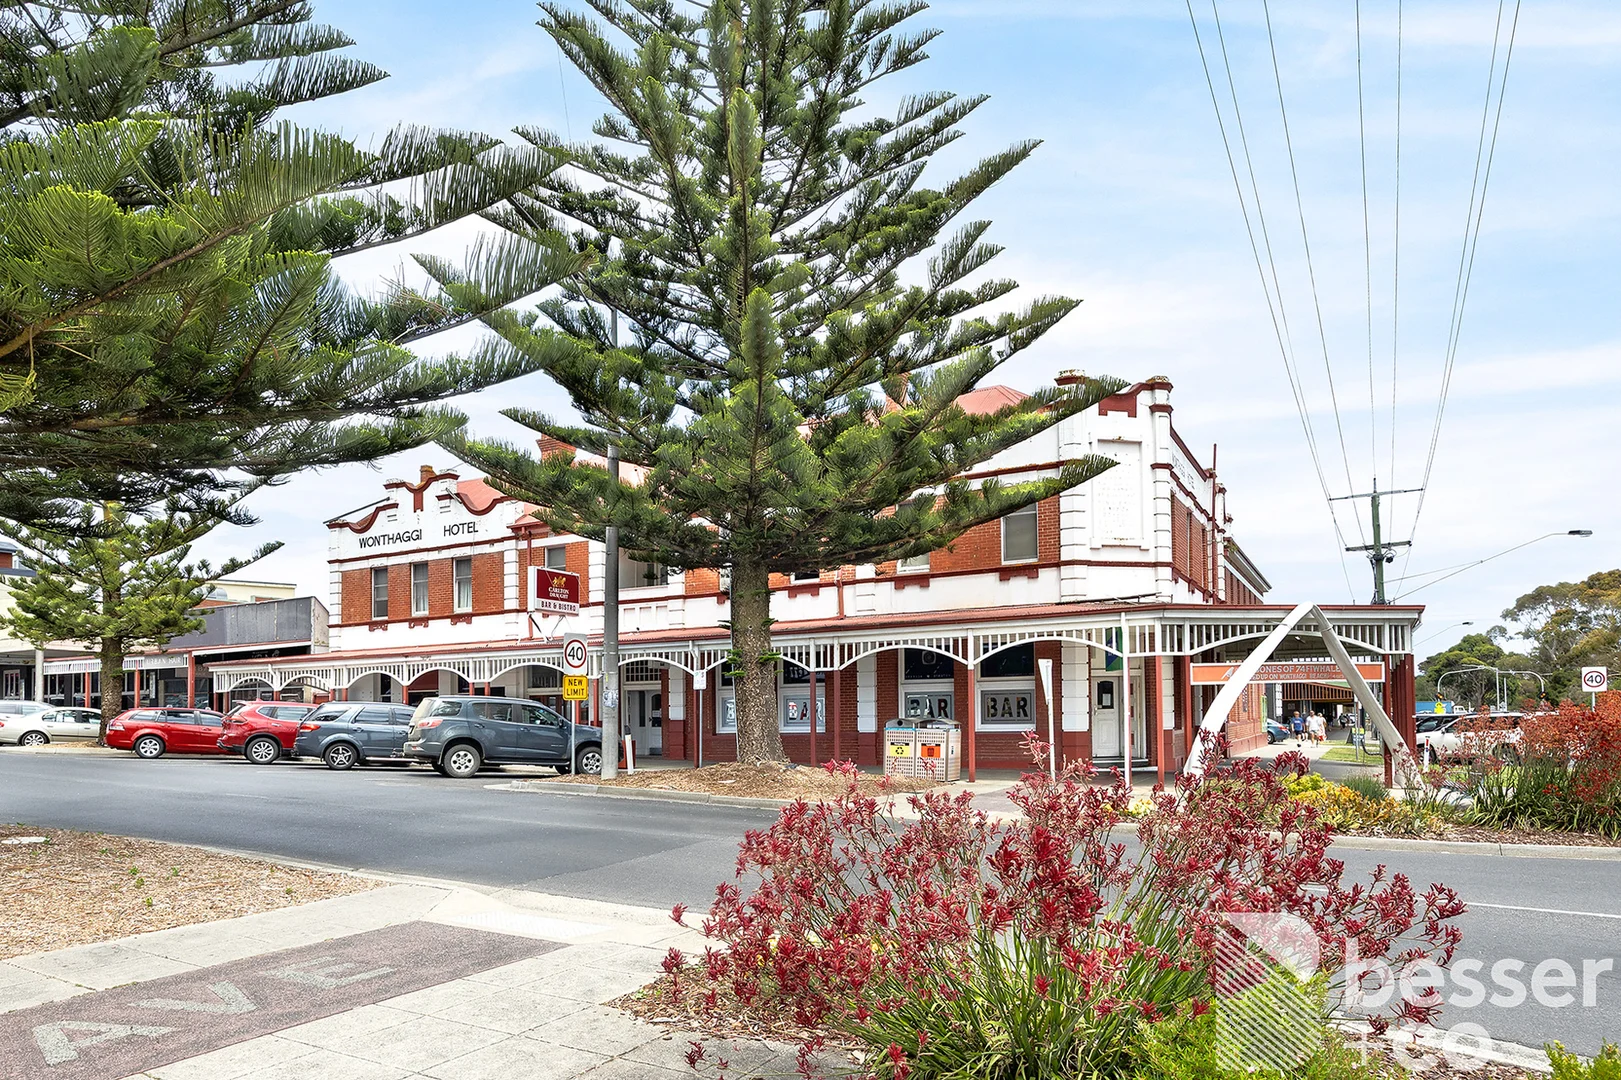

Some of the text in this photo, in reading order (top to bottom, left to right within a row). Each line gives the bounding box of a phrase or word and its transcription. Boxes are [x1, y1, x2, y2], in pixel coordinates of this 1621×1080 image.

[359, 521, 478, 548] WONTHAGGI HOTEL
[548, 586, 569, 595] CARLTON
[541, 600, 552, 609] BAR
[558, 603, 577, 612] BISTRO
[568, 646, 583, 661] 40
[1257, 665, 1282, 673] ONES
[1283, 665, 1295, 673] OF
[568, 679, 583, 687] NEW
[1586, 674, 1603, 684] 40
[566, 688, 585, 697] LIMIT
[910, 698, 949, 719] BAR
[987, 696, 1029, 718] BAR
[32, 955, 398, 1066] AVE
